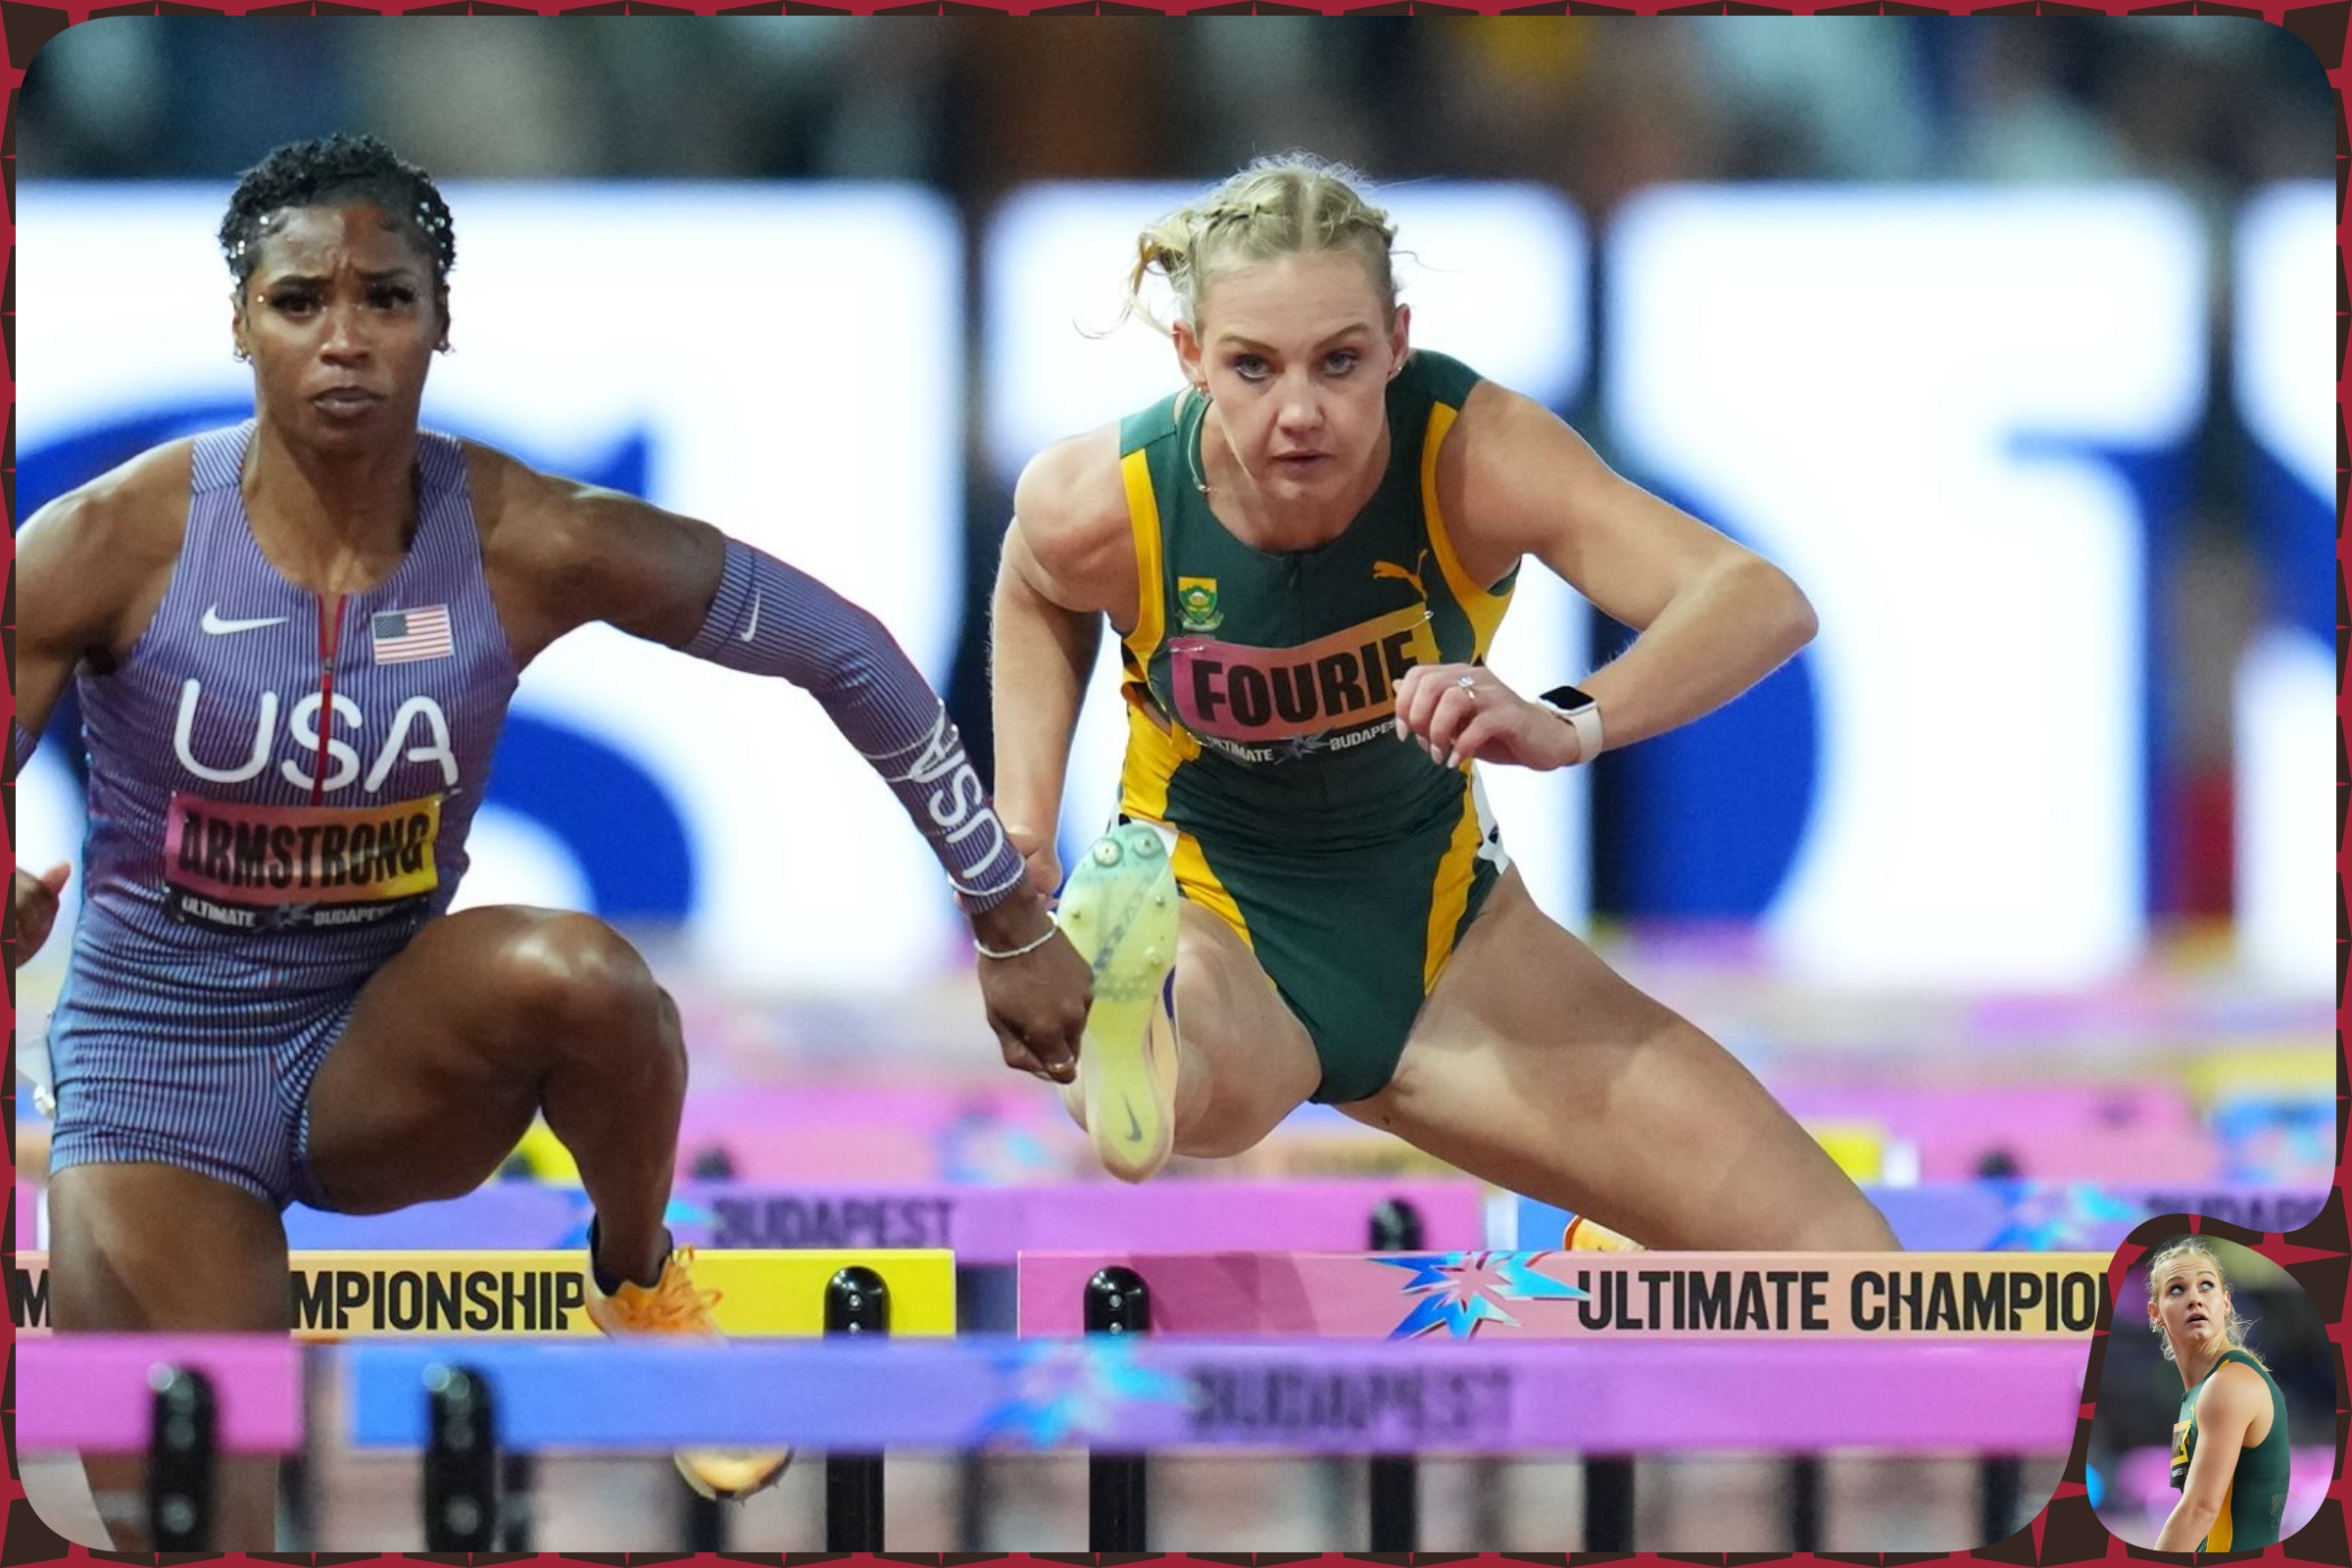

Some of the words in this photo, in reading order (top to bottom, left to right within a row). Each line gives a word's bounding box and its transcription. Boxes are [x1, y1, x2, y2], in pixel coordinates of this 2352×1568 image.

[174, 679, 459, 791] USA
[910, 698, 1004, 879] USA
[177, 809, 430, 889] ARMSTRONG
[181, 897, 256, 927] ULTIMATE
[289, 1270, 585, 1330] MPIONSHIP
[1578, 1271, 1829, 1330] ULTIMATE
[1851, 1271, 2107, 1331] CHAMPIO
